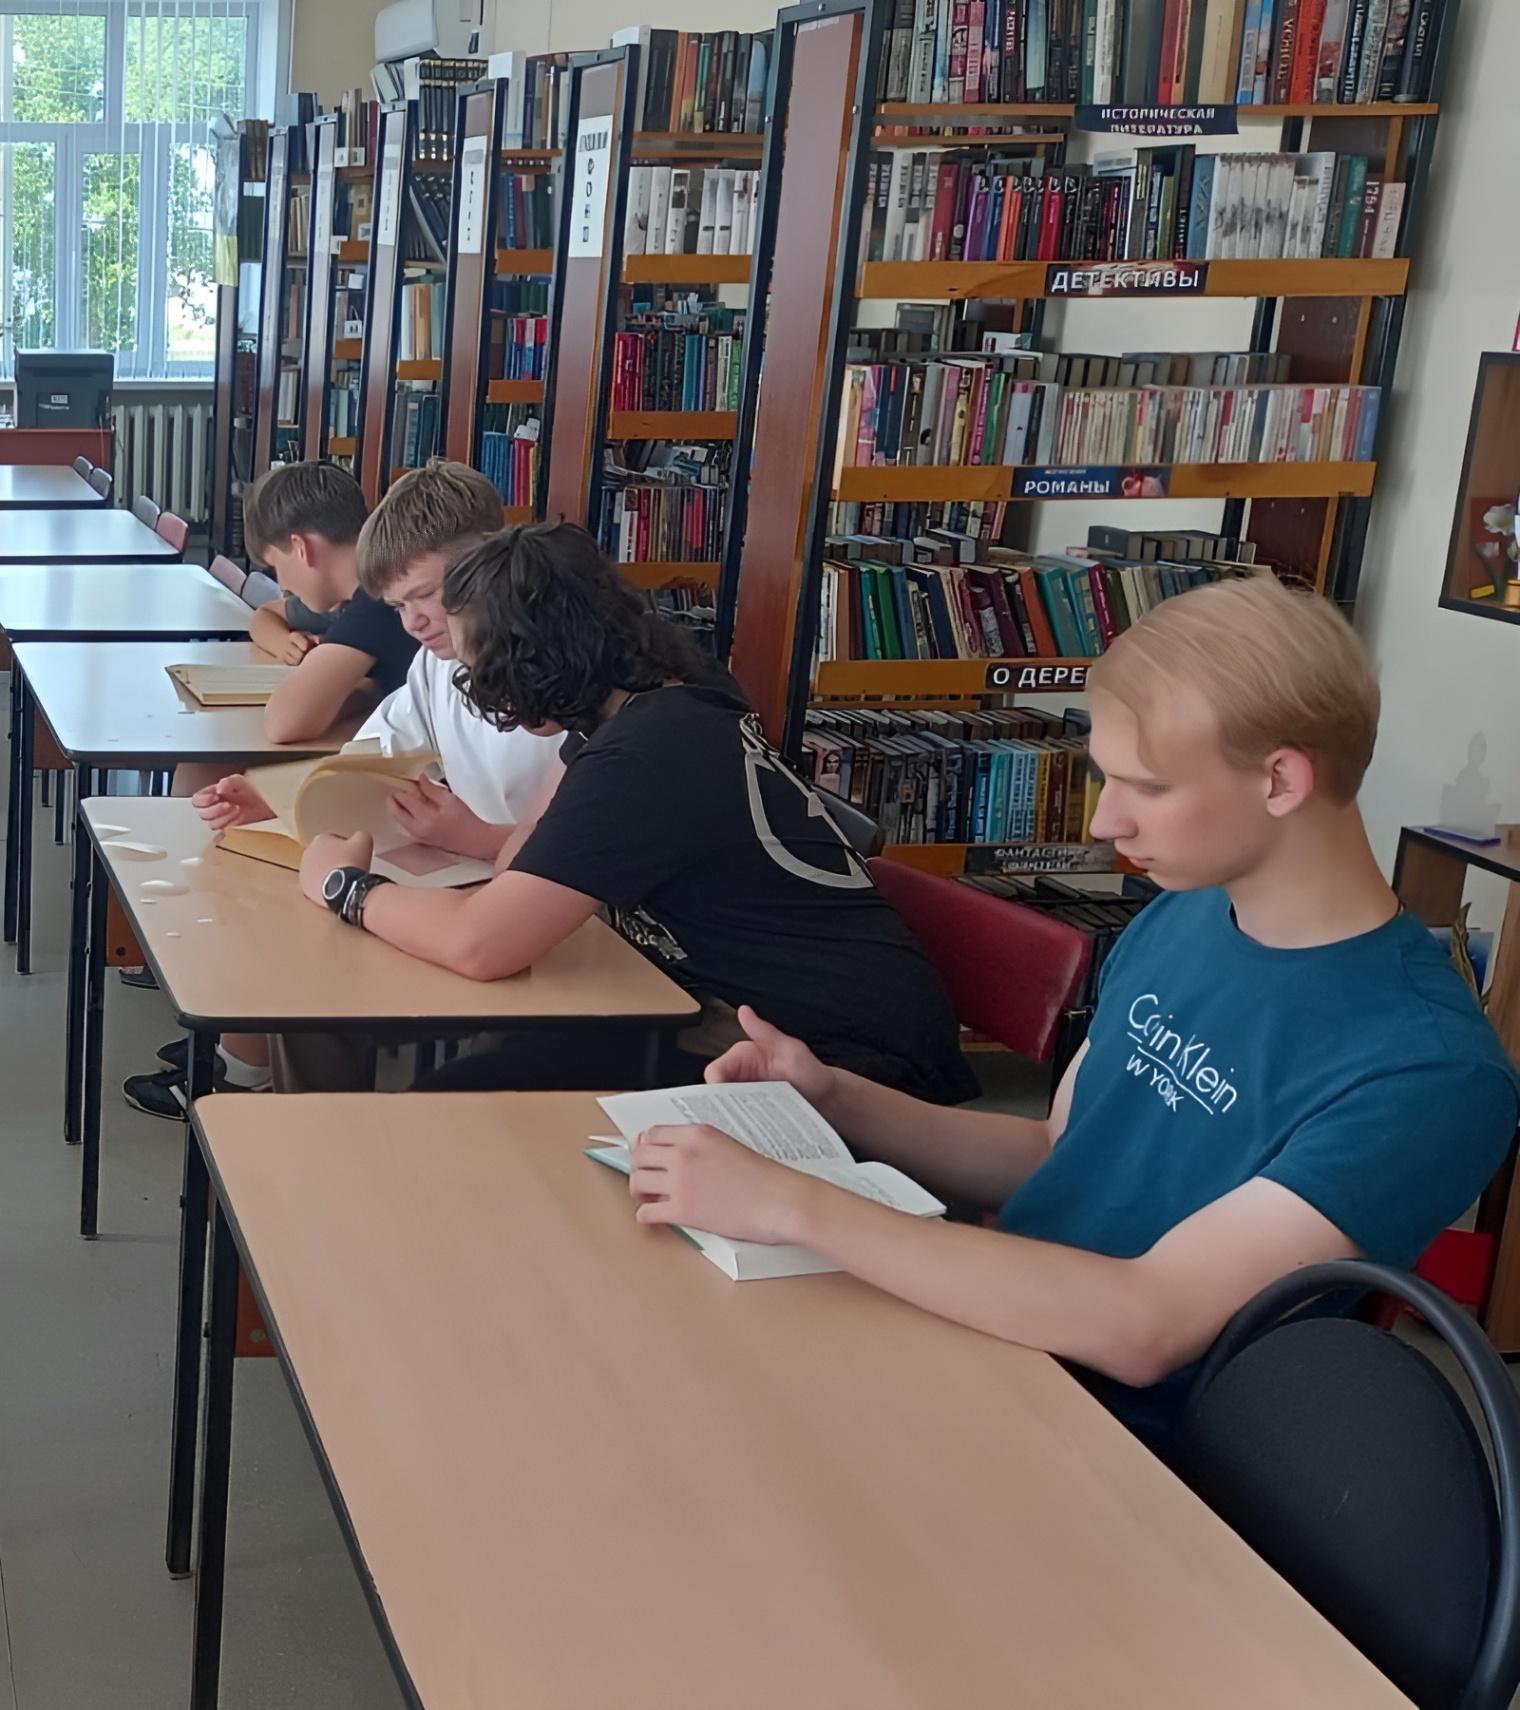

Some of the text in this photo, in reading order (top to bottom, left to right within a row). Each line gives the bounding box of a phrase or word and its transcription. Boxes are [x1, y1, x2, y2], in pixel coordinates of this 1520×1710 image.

[1050, 270, 1199, 293] ДЕТЕКТИВЫ
[1023, 480, 1111, 495] РОМАНЫ
[993, 667, 1010, 685] О
